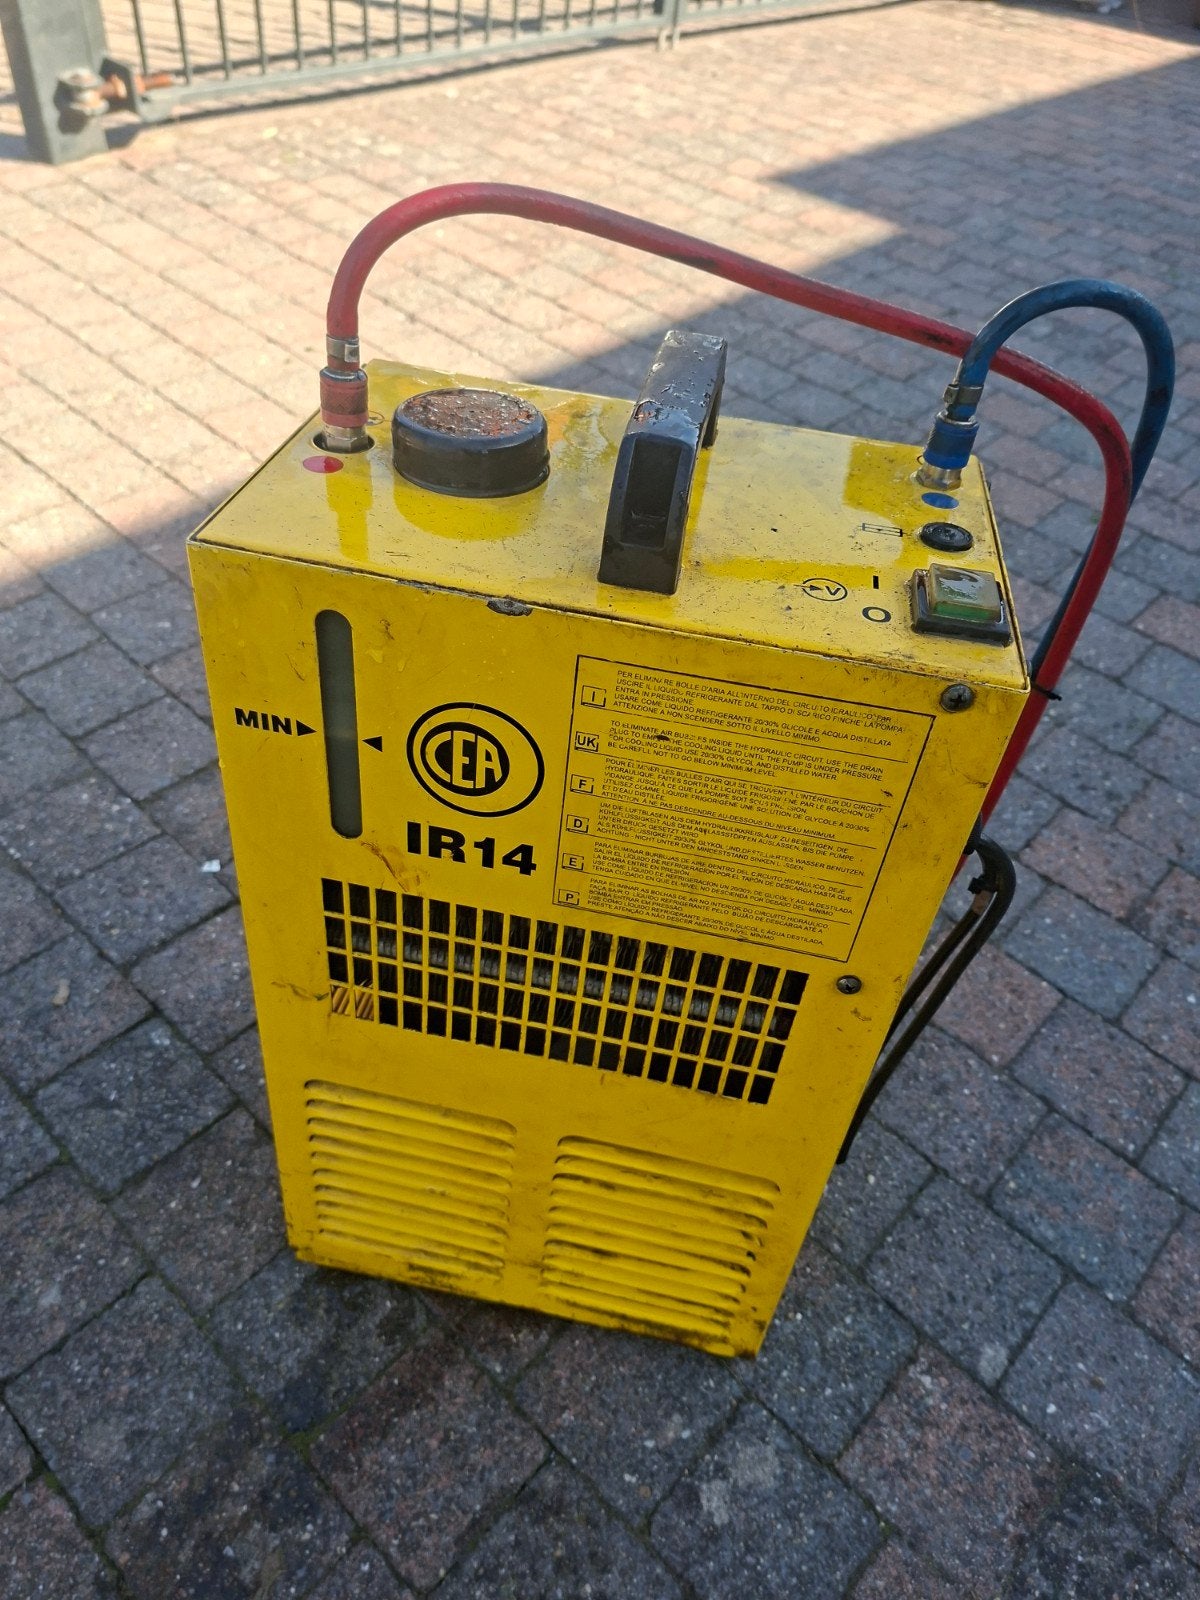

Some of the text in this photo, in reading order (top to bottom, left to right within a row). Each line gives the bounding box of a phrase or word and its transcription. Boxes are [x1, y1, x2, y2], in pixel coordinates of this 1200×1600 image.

[591, 691, 596, 702] I
[235, 707, 293, 735] MIN
[577, 735, 596, 748] UK
[425, 730, 504, 790] CEA
[578, 780, 587, 789] F
[573, 818, 583, 829] D
[406, 821, 538, 876] IR14
[569, 857, 578, 867] E
[565, 893, 574, 902] P
